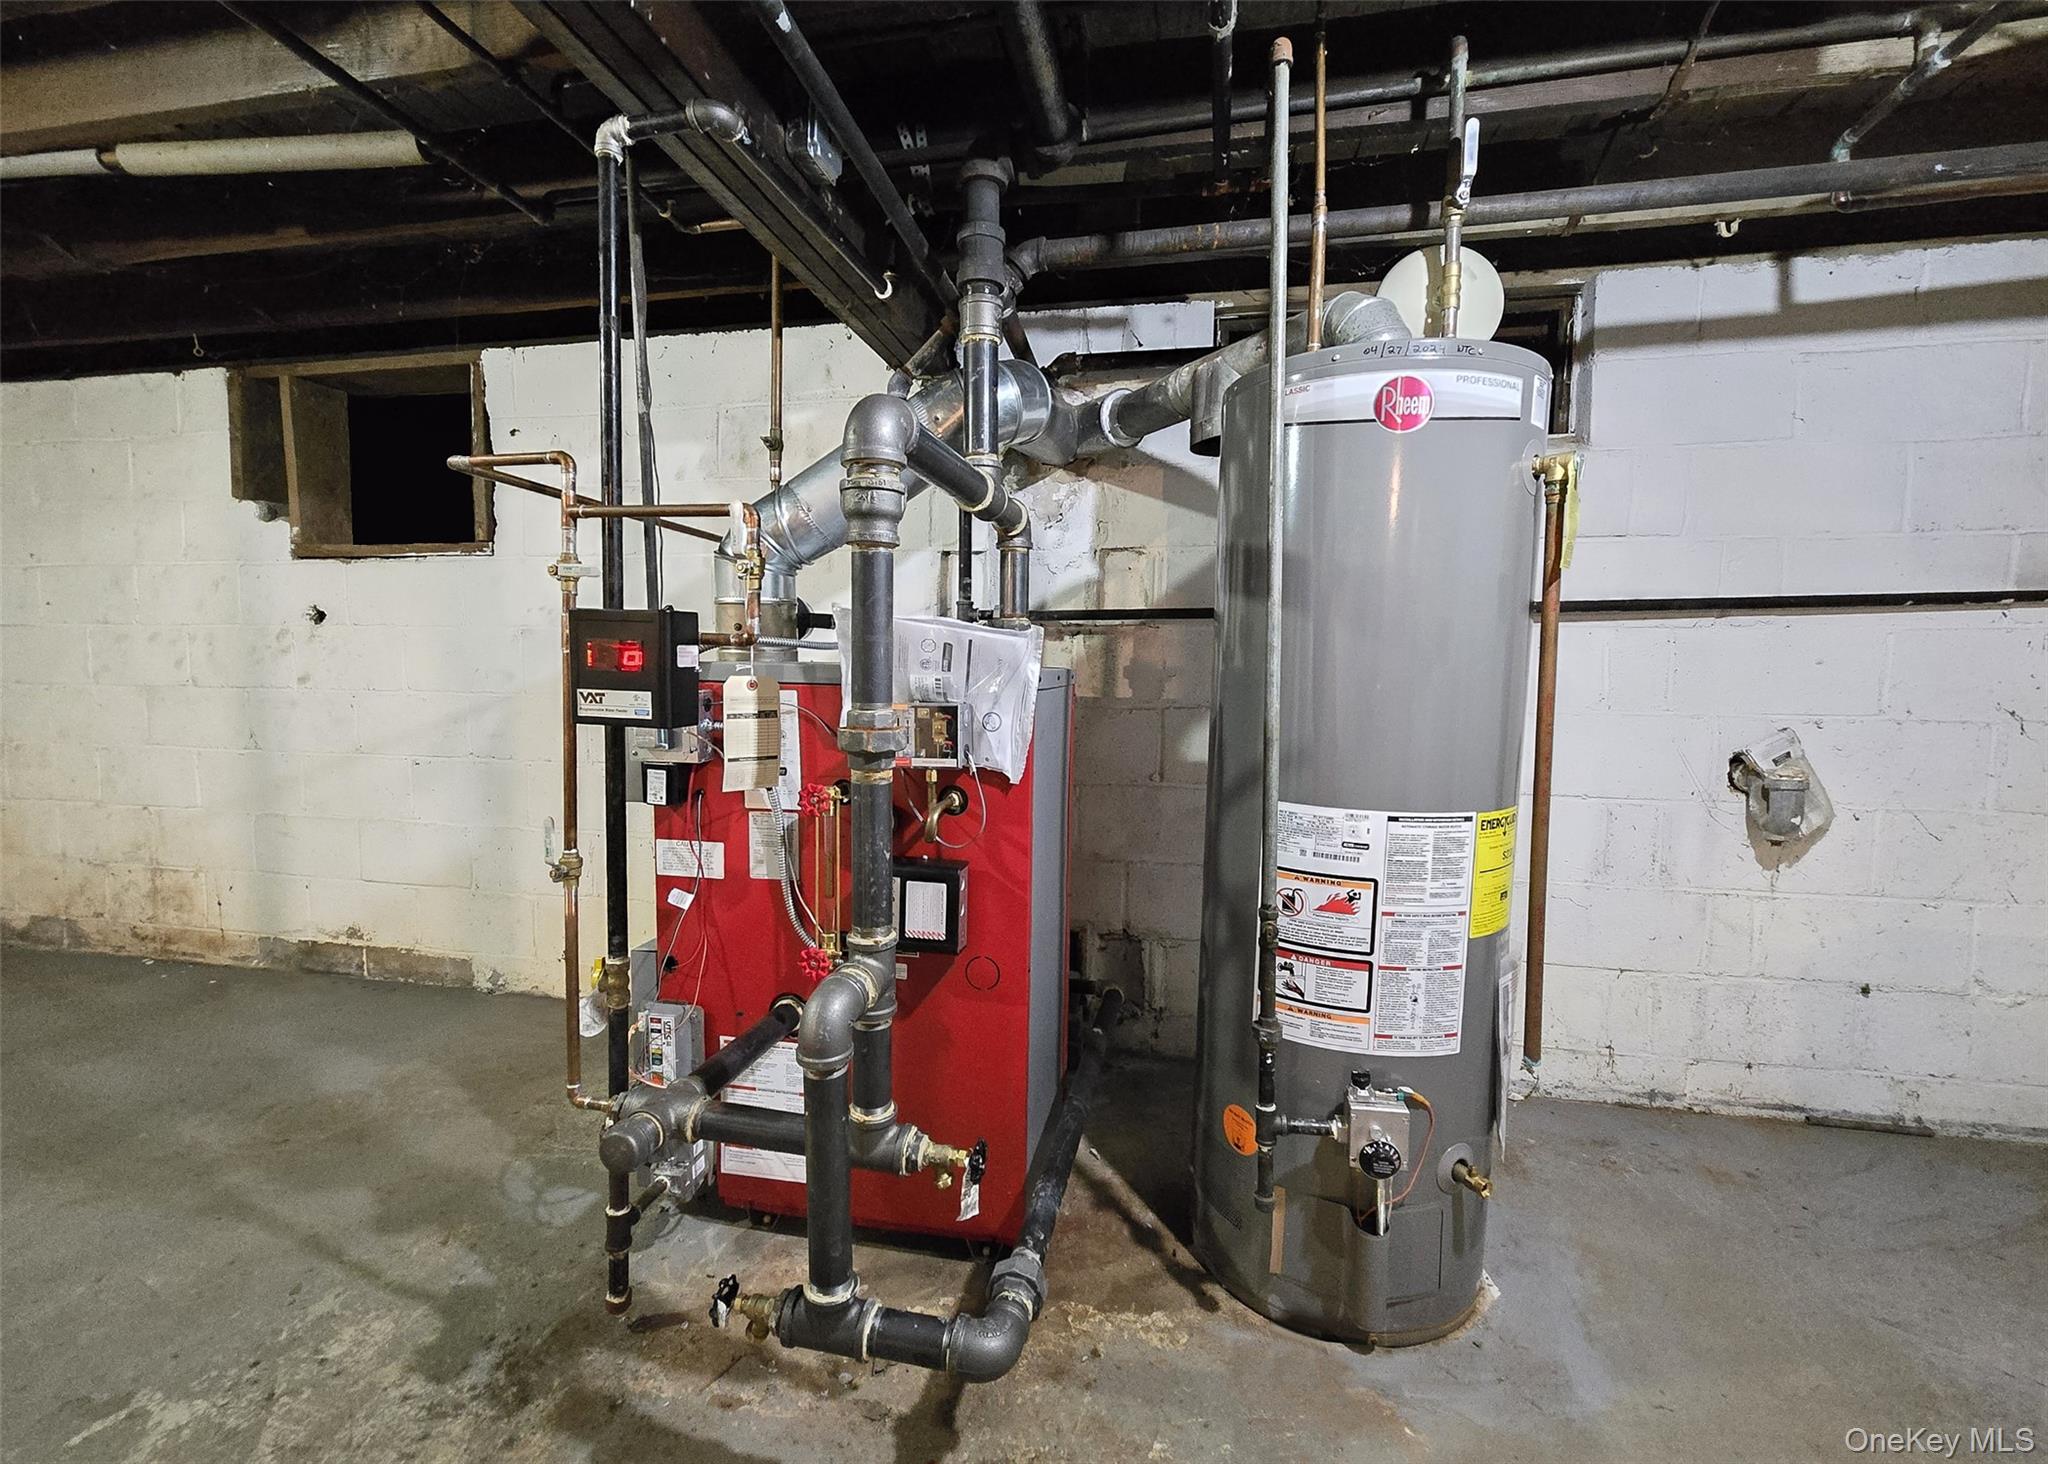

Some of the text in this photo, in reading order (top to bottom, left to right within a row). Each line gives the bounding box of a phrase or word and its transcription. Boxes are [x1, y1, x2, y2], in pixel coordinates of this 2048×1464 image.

[1456, 374, 1520, 392] PROFESSIONAL
[1285, 384, 1311, 397] LASSIC
[1380, 376, 1431, 424] Rheem
[1303, 875, 1342, 887] WARNING
[1298, 955, 1332, 967] DANGER
[1297, 1008, 1332, 1020] WARNING
